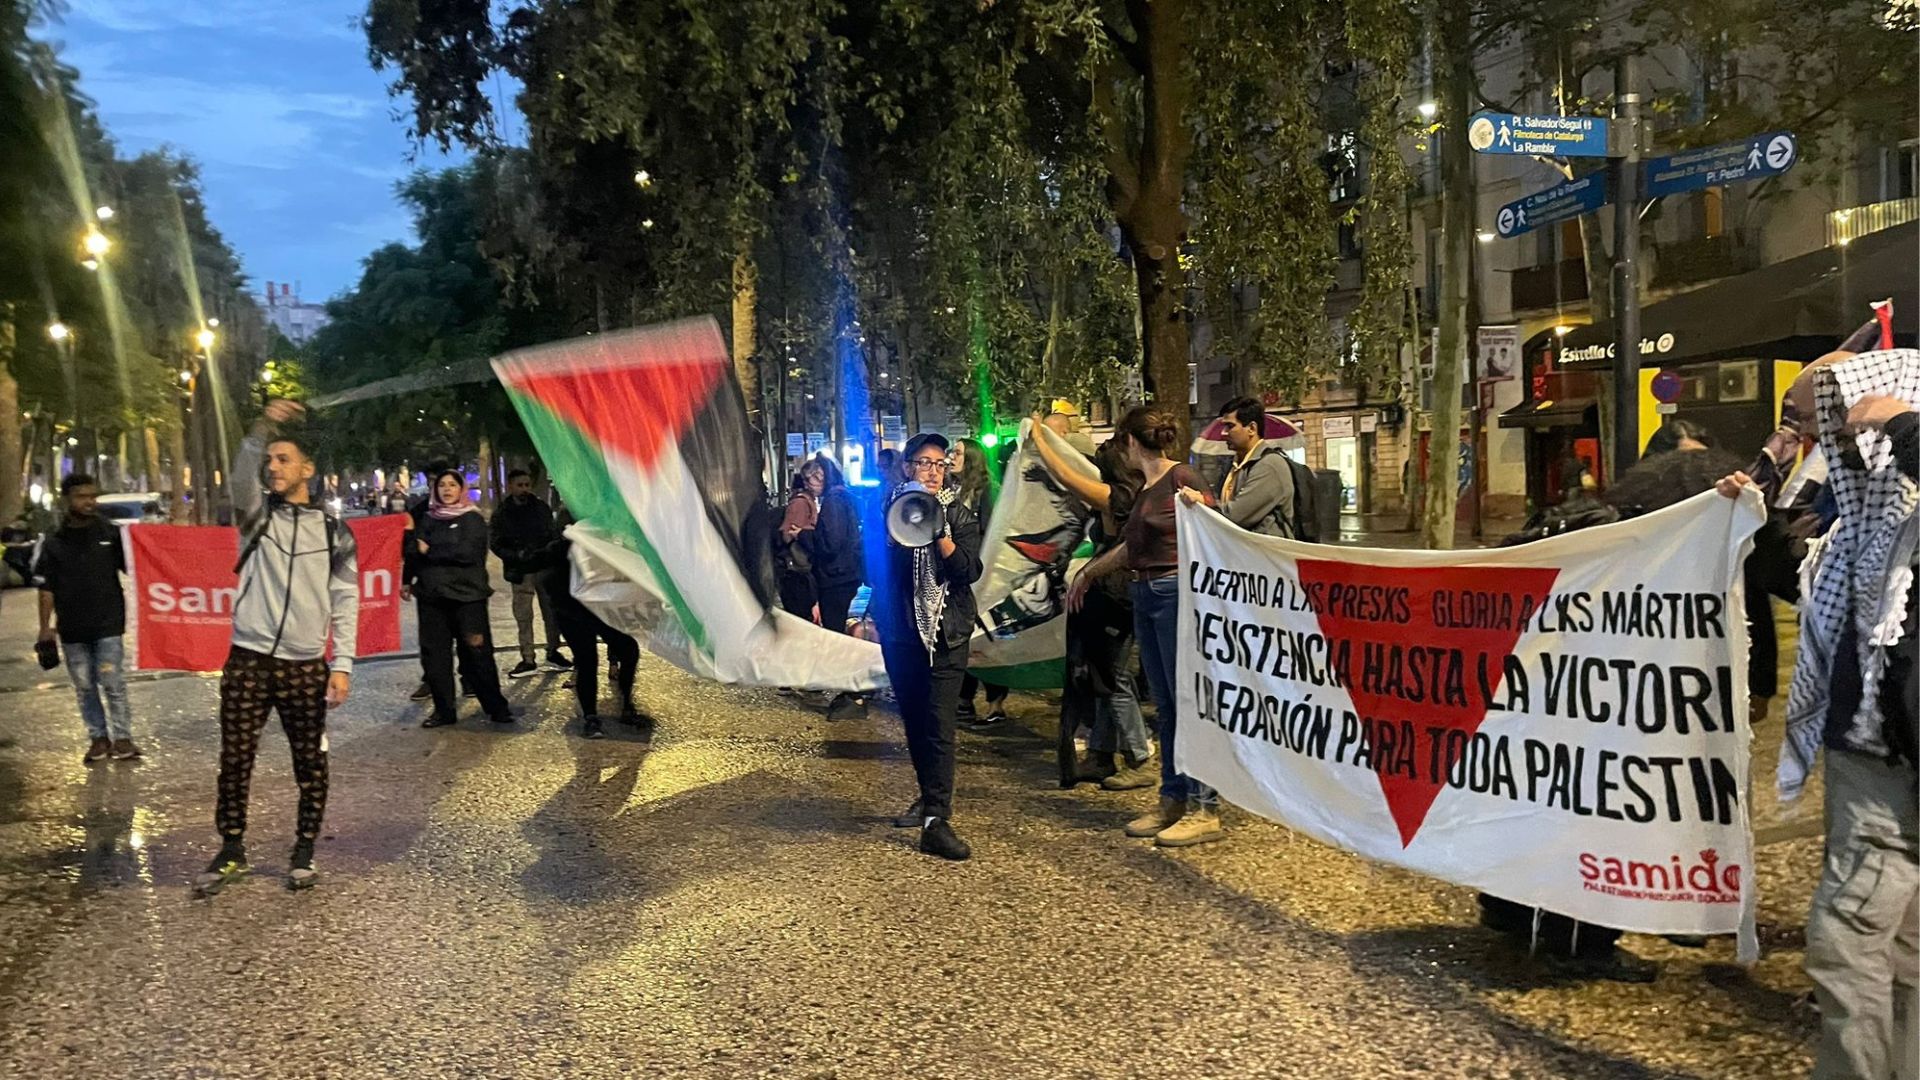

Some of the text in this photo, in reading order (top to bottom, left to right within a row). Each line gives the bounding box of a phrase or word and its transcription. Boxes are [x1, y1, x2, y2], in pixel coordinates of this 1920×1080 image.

[1525, 117, 1560, 130] Salvador
[1544, 131, 1553, 140] de
[1513, 142, 1556, 154] La Rambla
[1558, 344, 1606, 363] Estrella
[1271, 576, 1285, 609] A
[1289, 579, 1325, 616] LXS
[1328, 582, 1412, 625] PRESXS
[1432, 589, 1513, 632] GLORIA
[1515, 593, 1535, 633] A
[1602, 584, 1727, 640] MÁRTIR
[1361, 641, 1469, 708] HASTA
[1477, 651, 1530, 714] LA
[1335, 710, 1417, 780] PARA
[1425, 726, 1518, 801] TODA
